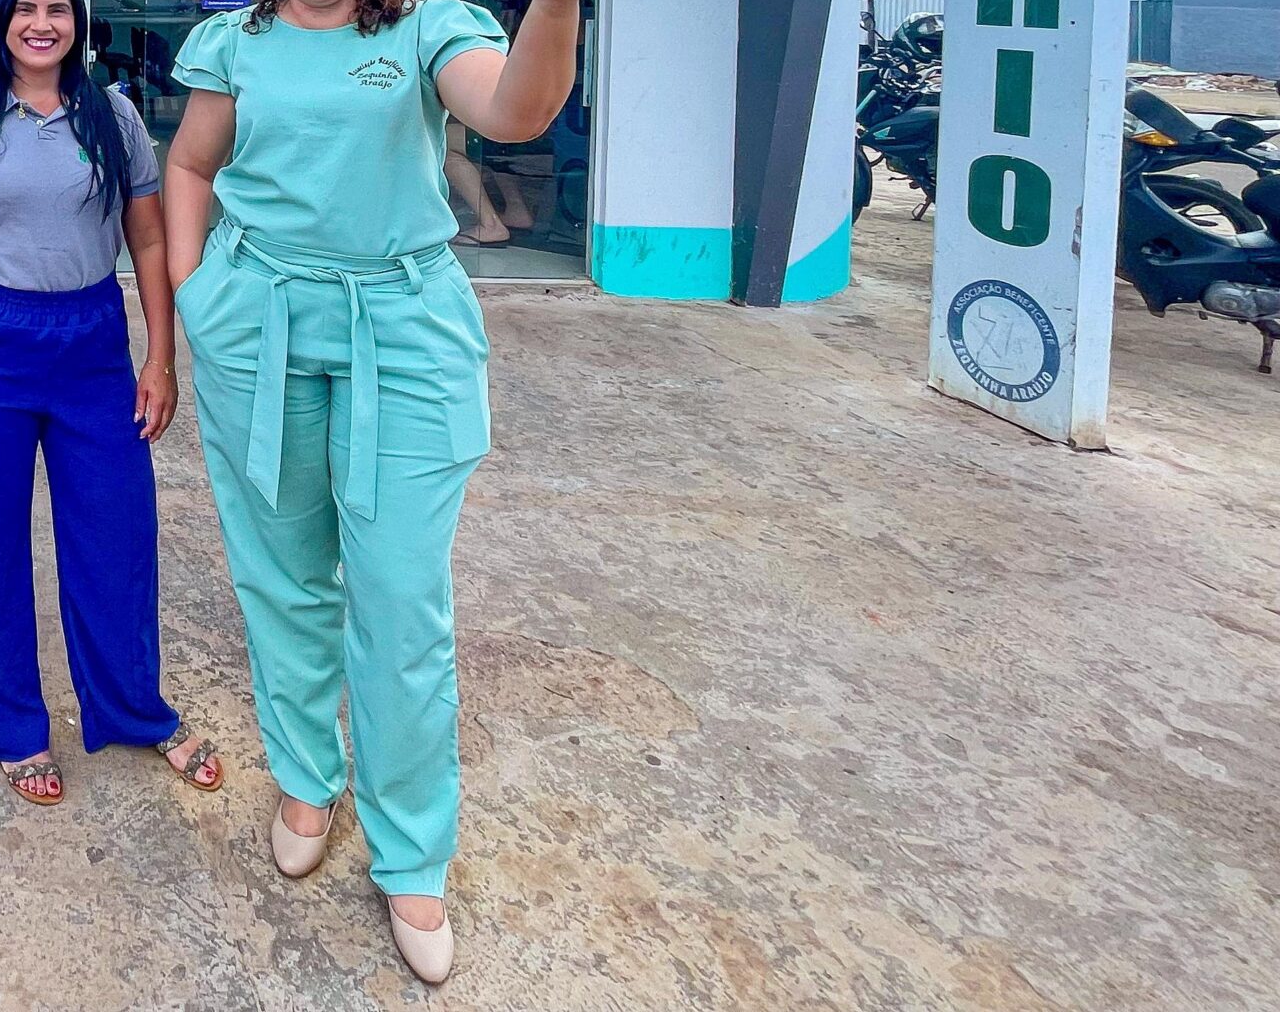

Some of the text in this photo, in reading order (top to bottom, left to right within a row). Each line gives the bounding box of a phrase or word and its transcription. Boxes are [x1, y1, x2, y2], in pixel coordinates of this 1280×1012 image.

[954, 283, 1055, 345] ASSOCIAÇÃO BENEFICENTE
[952, 339, 1008, 398] ZEQUINHA
